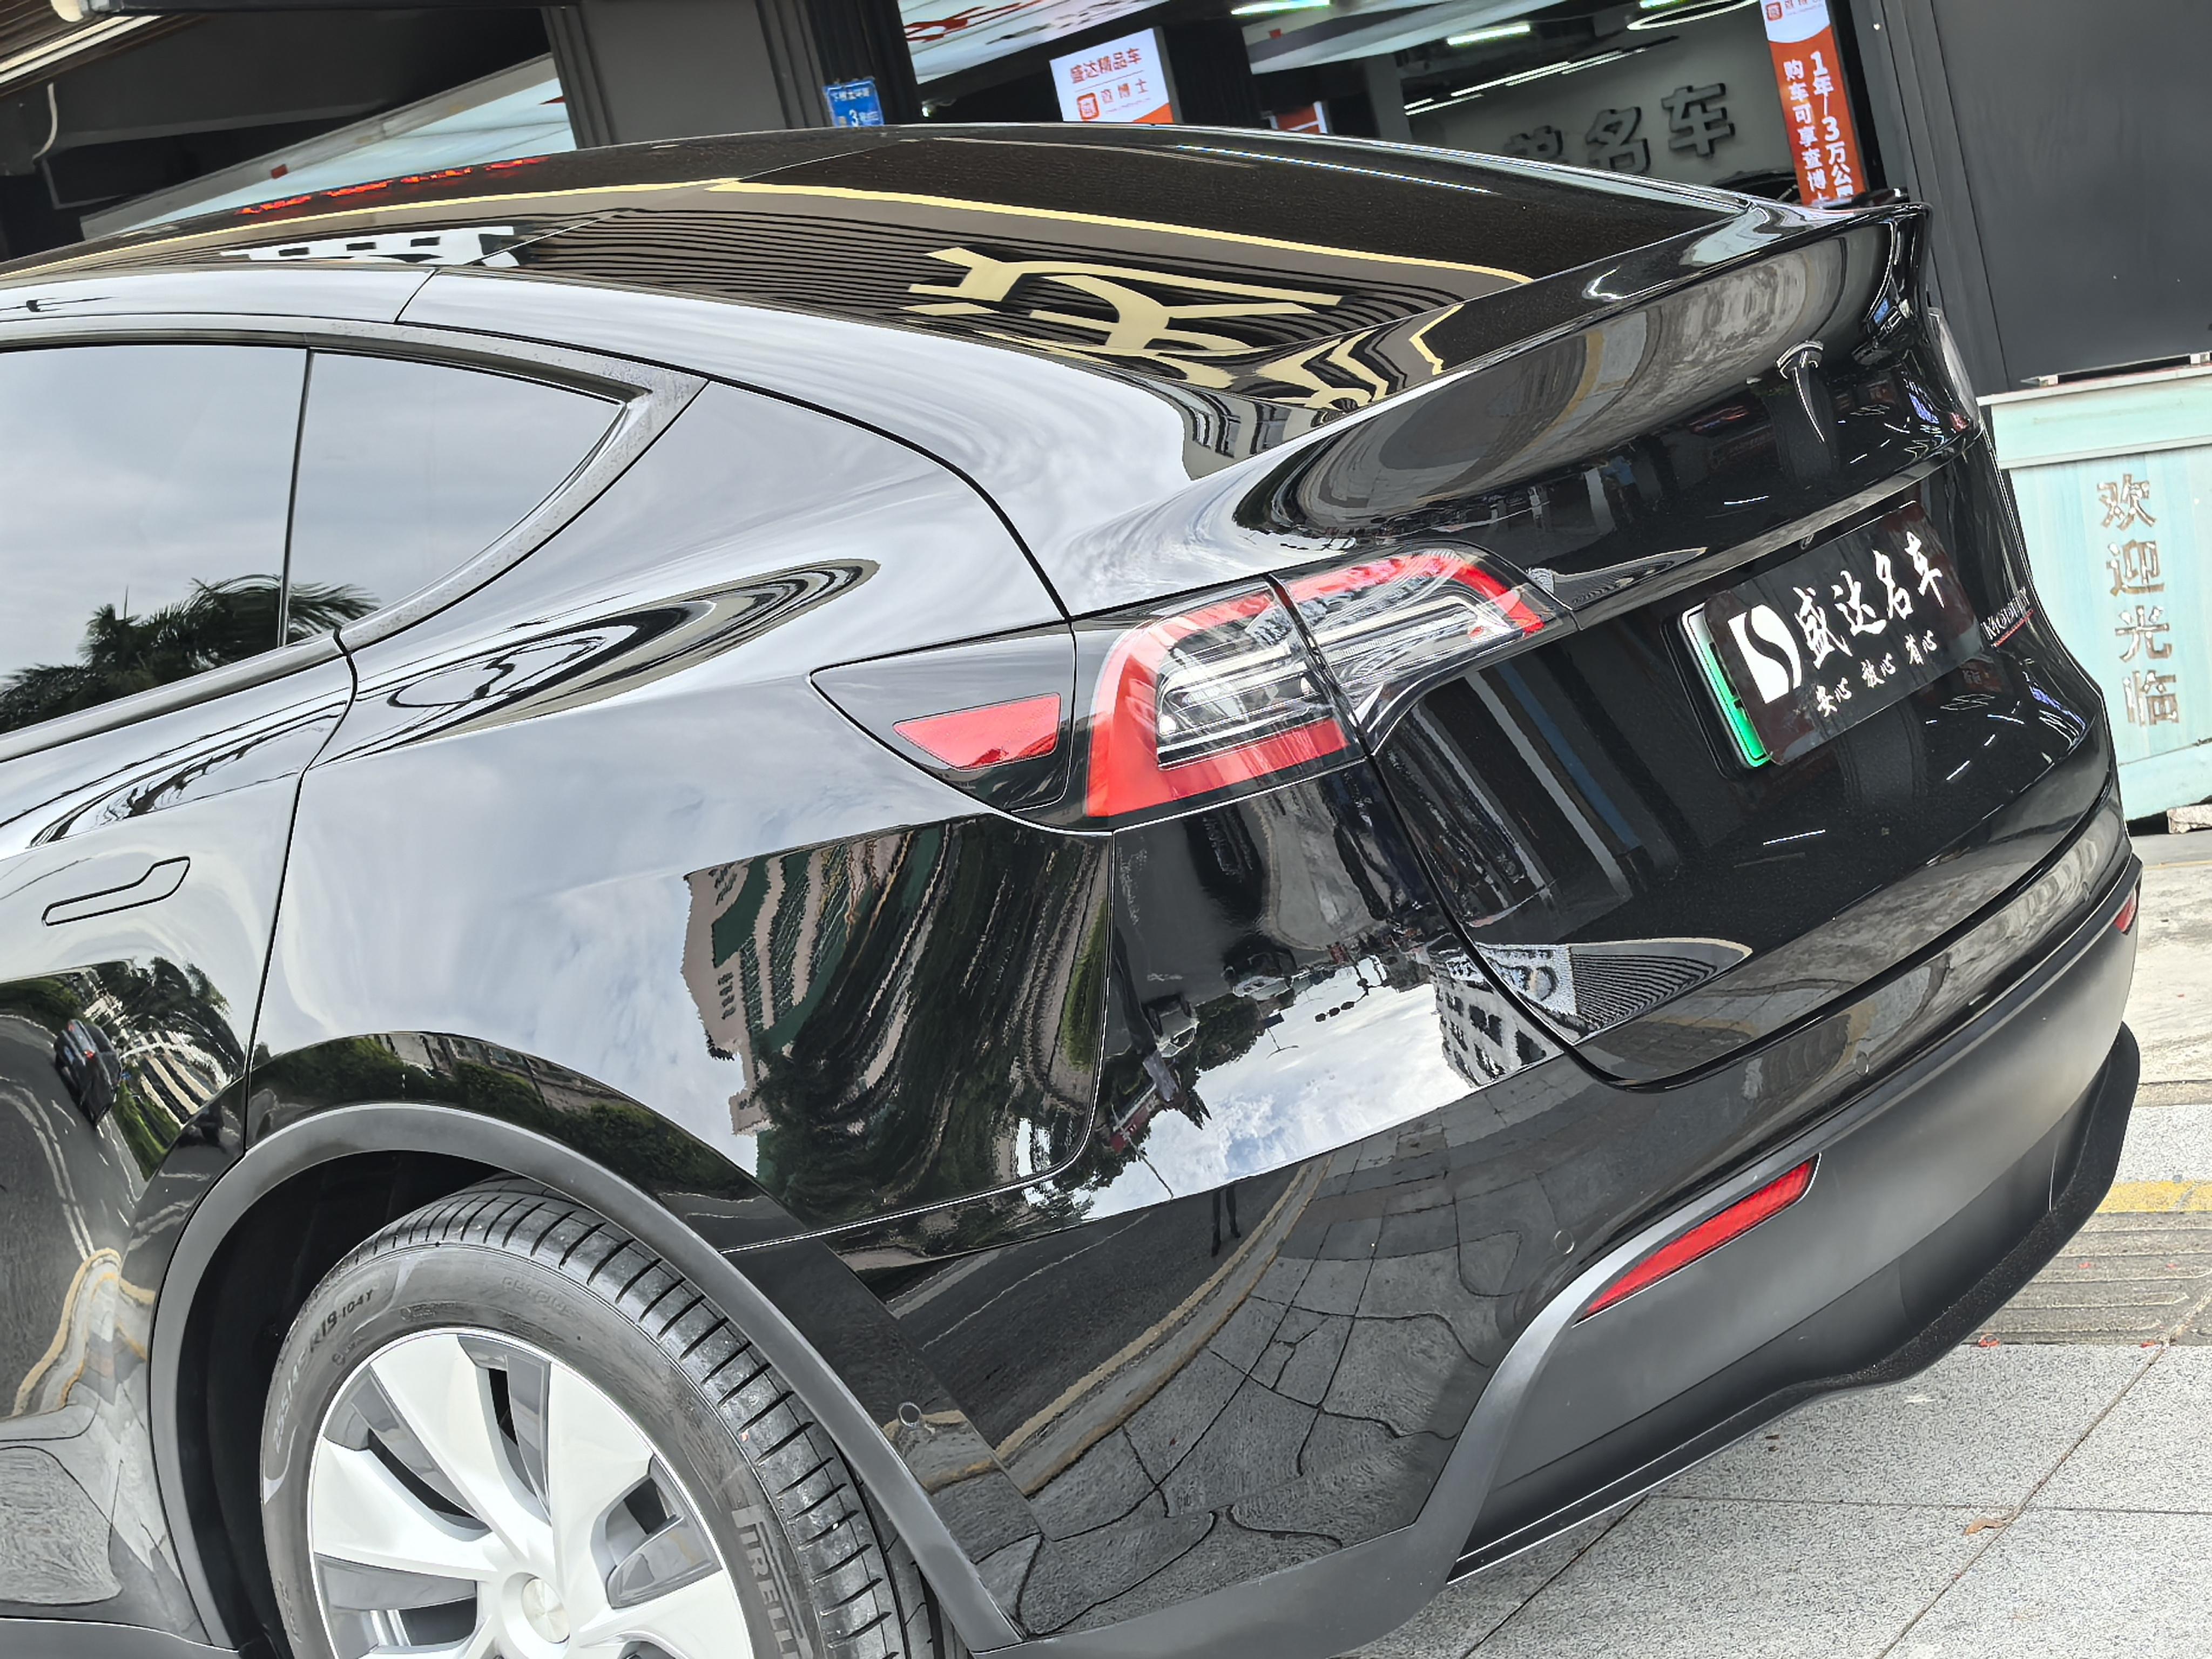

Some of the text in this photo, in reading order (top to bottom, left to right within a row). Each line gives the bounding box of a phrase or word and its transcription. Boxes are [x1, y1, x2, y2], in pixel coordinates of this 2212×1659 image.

[2097, 473, 2179, 726] 欢迎光临
[1816, 677, 1852, 717] 安心
